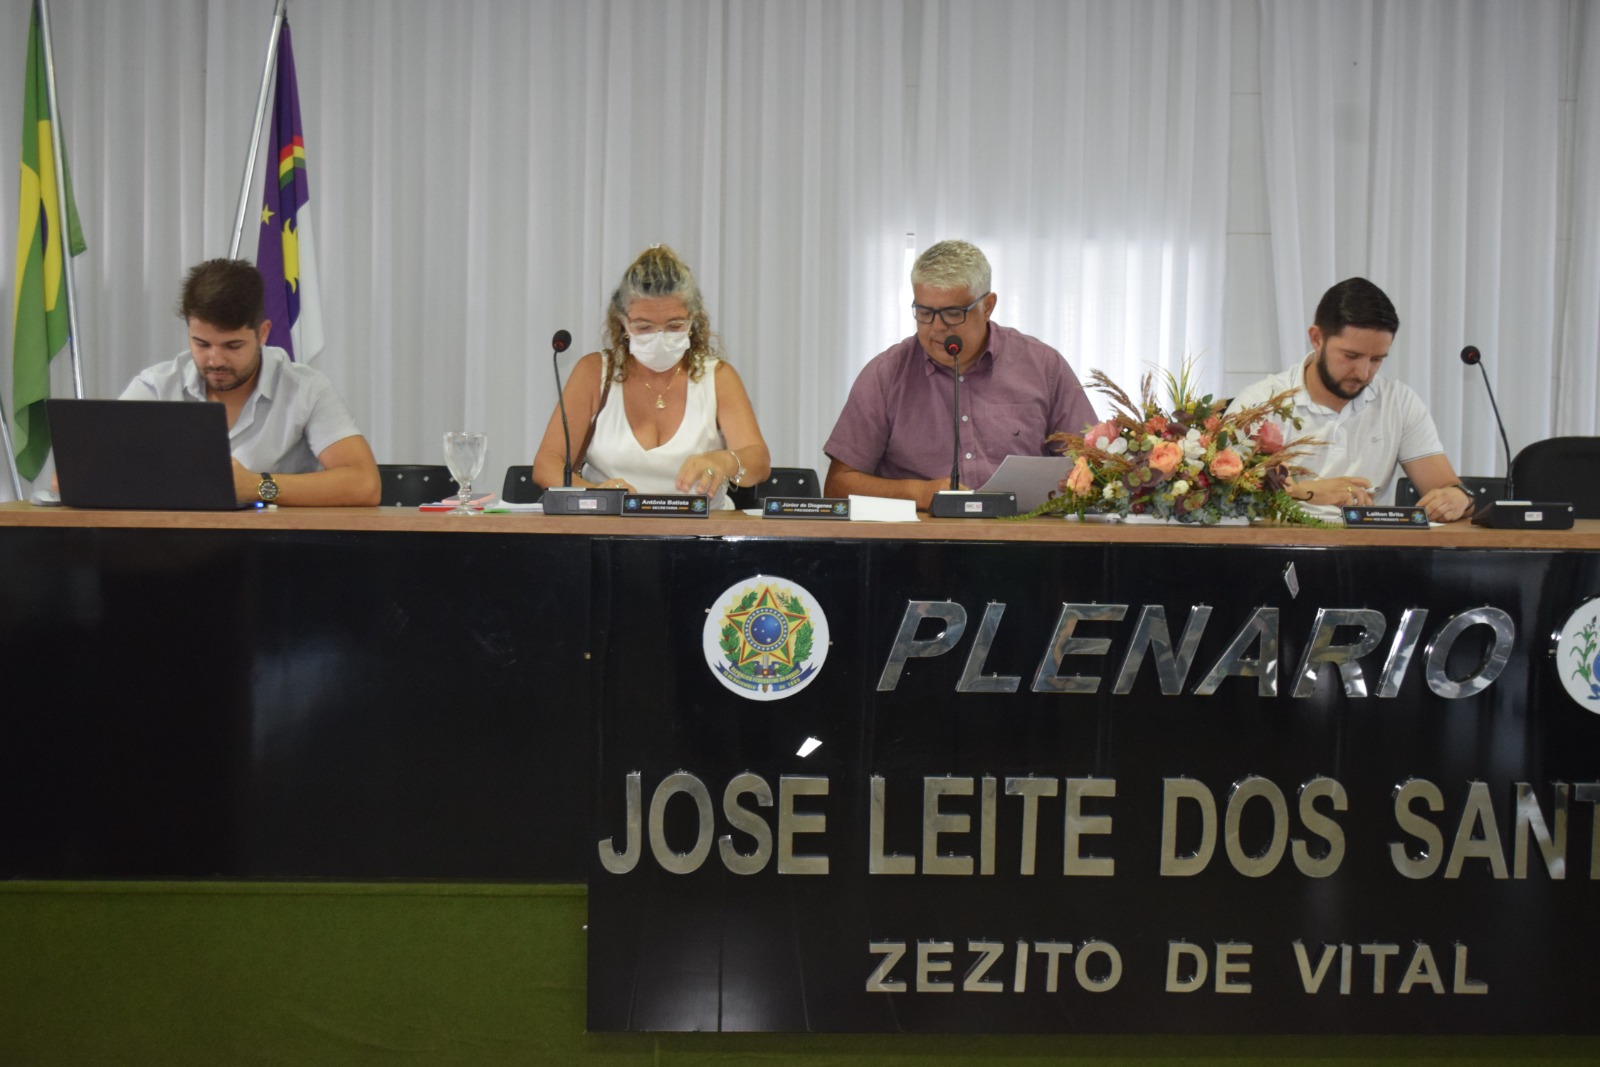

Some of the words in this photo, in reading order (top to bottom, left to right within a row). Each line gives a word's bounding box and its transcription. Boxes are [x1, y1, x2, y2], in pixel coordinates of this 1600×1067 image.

[876, 561, 1515, 698] PLENÁRIO
[598, 737, 830, 875] JOSÉ
[868, 772, 1117, 877] LEITE
[1160, 775, 1348, 878] DOS
[866, 940, 1123, 994] ZEZITO
[1165, 941, 1253, 994] DE
[1292, 941, 1489, 995] VITAL
